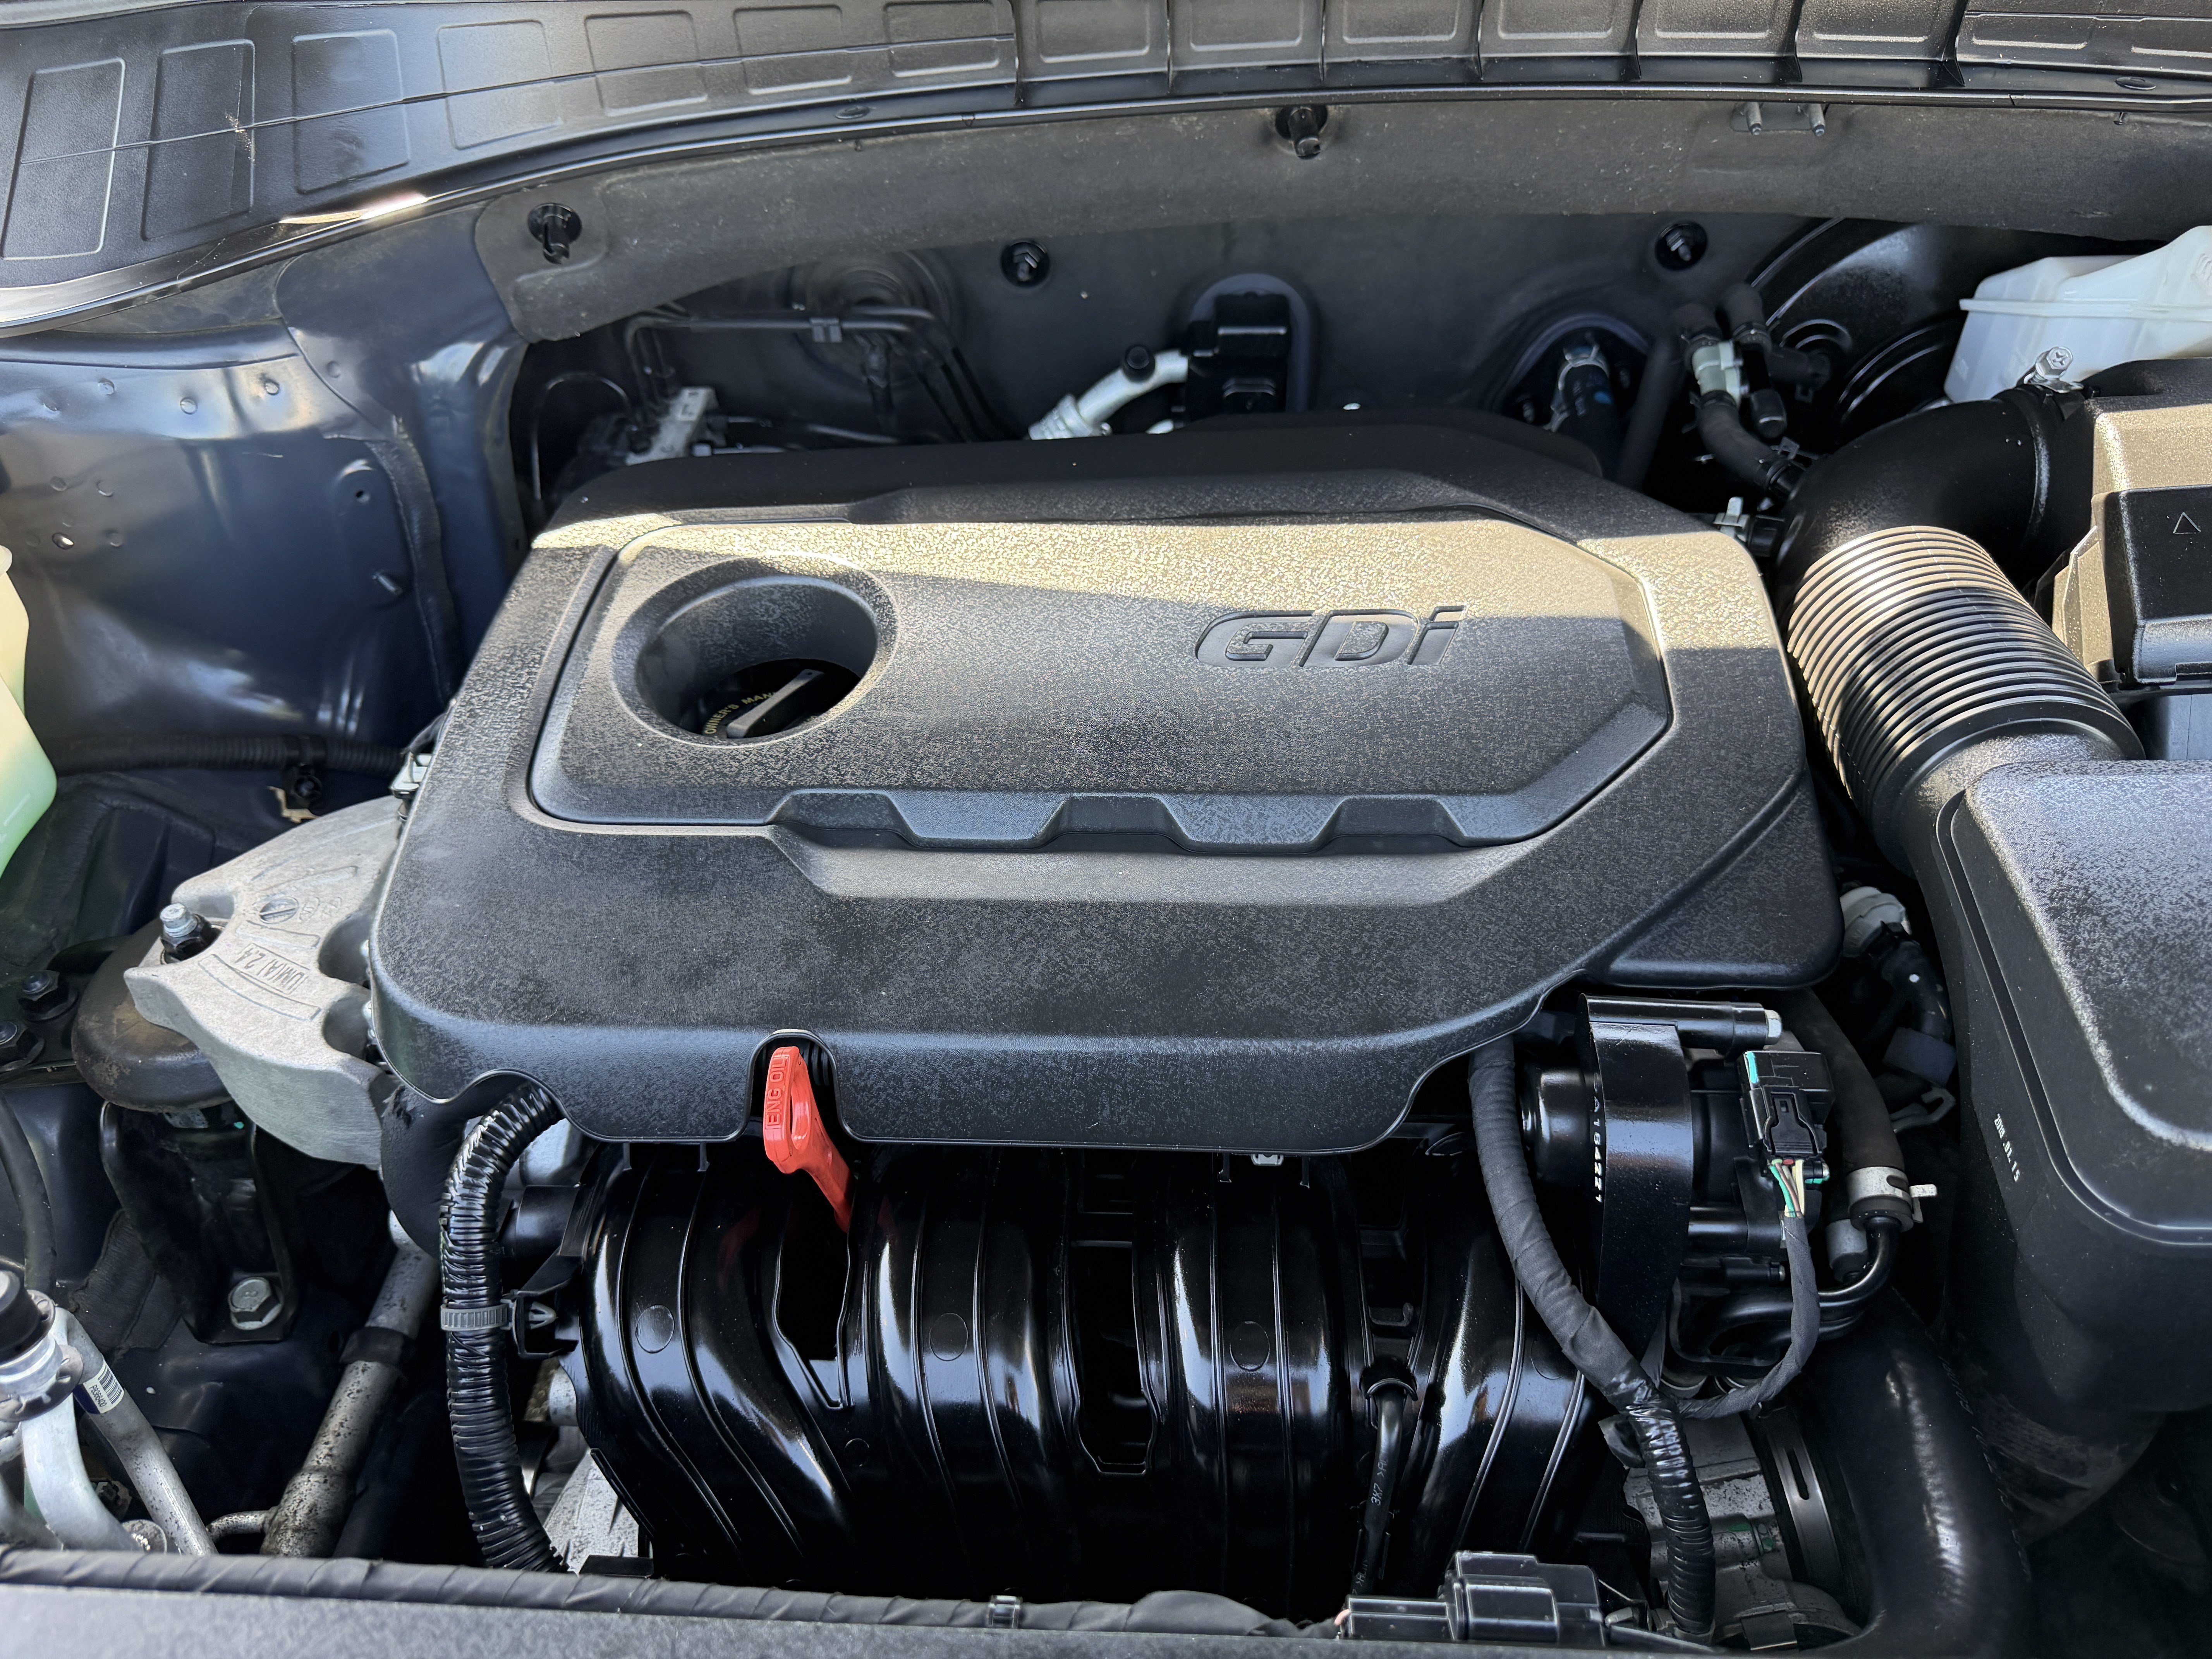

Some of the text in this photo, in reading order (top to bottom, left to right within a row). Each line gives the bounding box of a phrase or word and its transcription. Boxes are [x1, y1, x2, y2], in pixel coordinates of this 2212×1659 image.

[1194, 605, 1466, 668] GDi
[704, 692, 776, 734] OWNER'S MAN
[767, 1058, 787, 1125] ENG OIL
